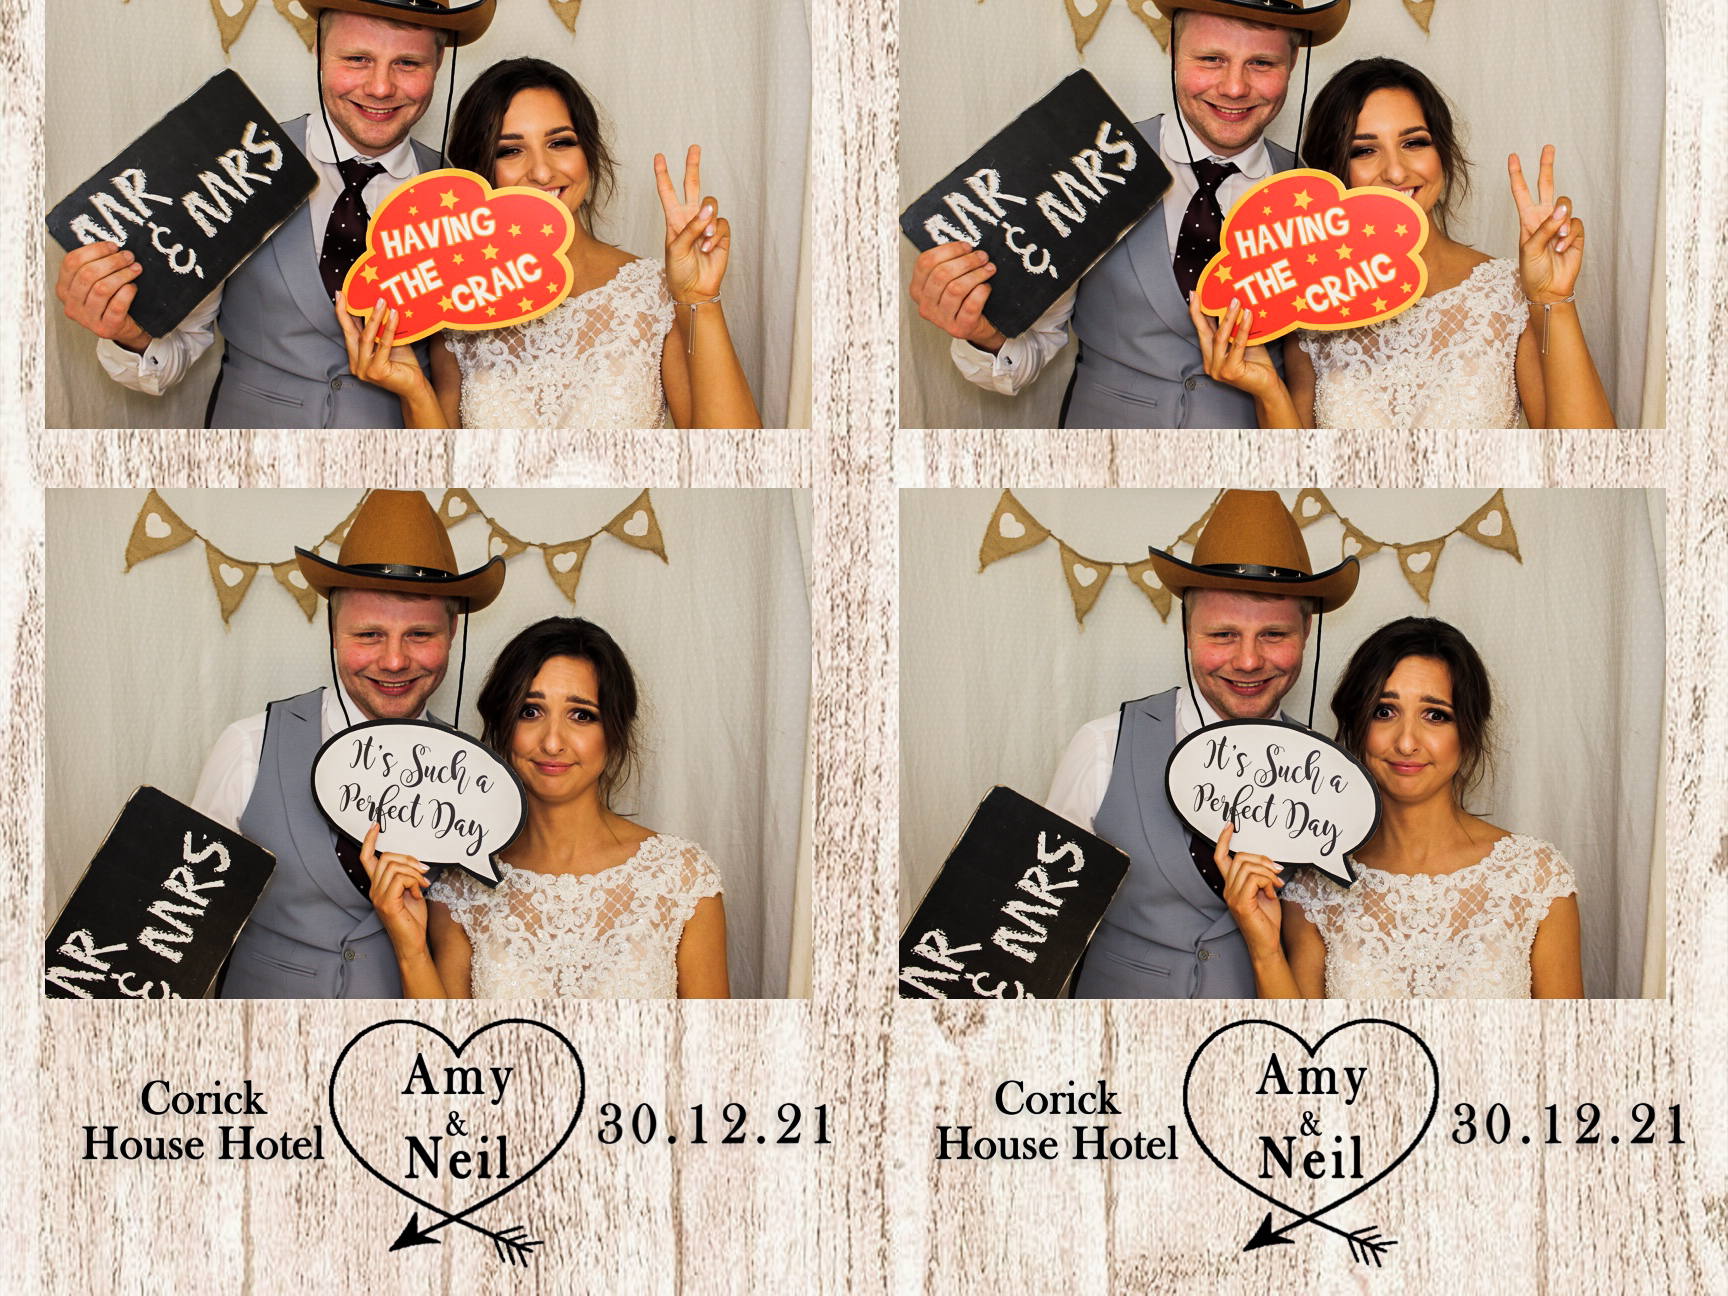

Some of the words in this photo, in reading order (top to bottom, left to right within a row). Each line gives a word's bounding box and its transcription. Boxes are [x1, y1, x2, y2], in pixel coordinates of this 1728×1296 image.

[147, 221, 205, 279] &
[380, 207, 496, 260] HAVING
[1001, 221, 1059, 279] &
[1234, 207, 1350, 260] HAVING
[379, 257, 444, 306] THE
[451, 253, 543, 313] CRAIC
[1233, 257, 1298, 306] THE
[1305, 253, 1397, 313] CRAIC
[350, 736, 398, 777] It's
[400, 744, 471, 795] Such
[475, 774, 495, 794] a
[1204, 736, 1252, 777] It's
[1254, 744, 1325, 795] Such
[1329, 774, 1349, 794] a
[339, 782, 424, 834] Perfect
[428, 798, 490, 857] Day
[1193, 782, 1278, 834] Perfect
[1282, 798, 1344, 857] Day
